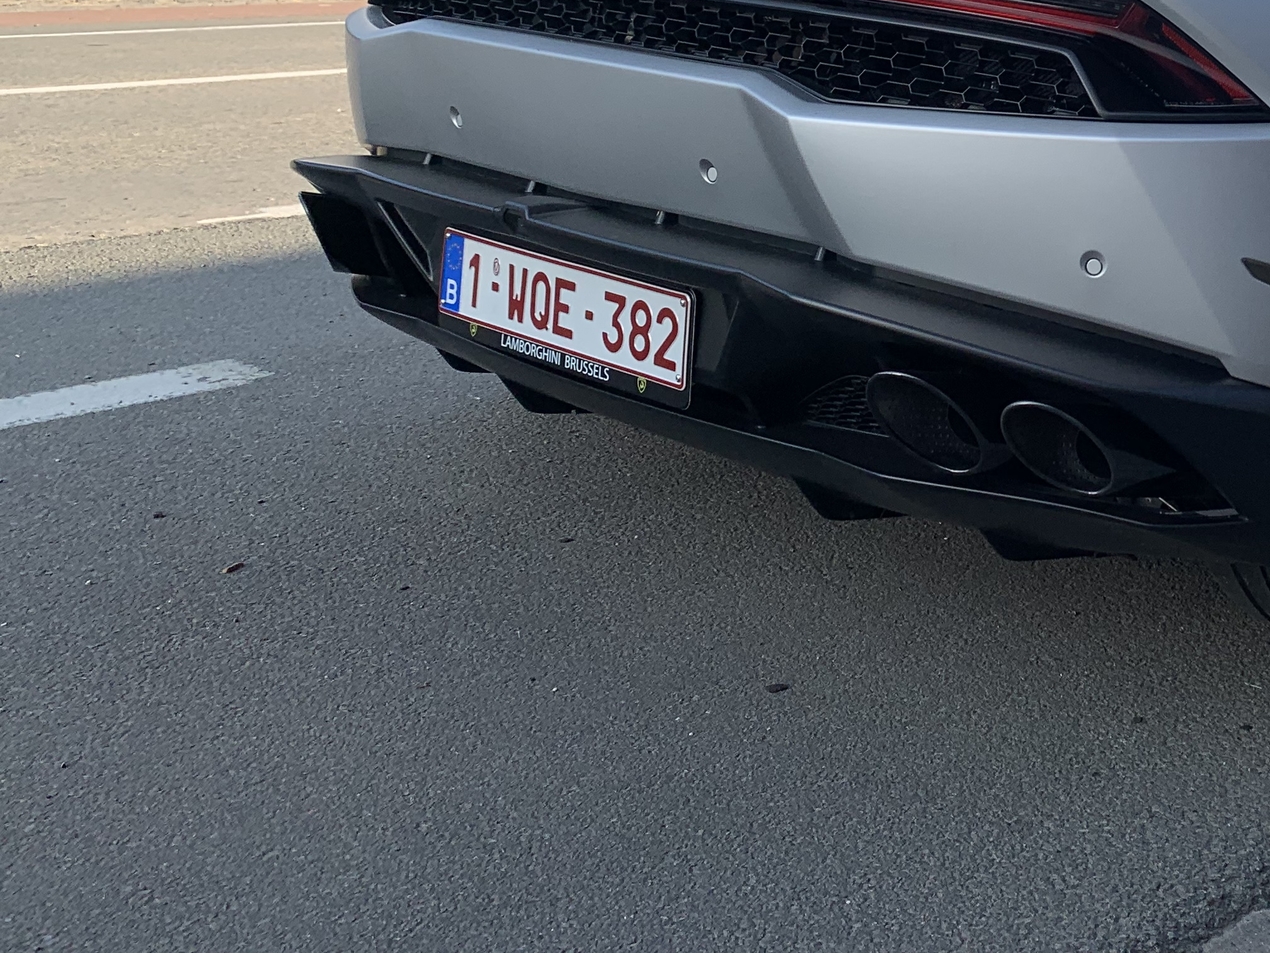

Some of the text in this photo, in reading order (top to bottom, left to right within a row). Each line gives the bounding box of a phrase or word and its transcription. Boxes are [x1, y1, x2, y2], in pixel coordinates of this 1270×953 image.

[446, 279, 458, 305] B
[468, 253, 679, 372] 1-WQE-382
[500, 333, 610, 381] LAMBORGHINI BRUSSELS
